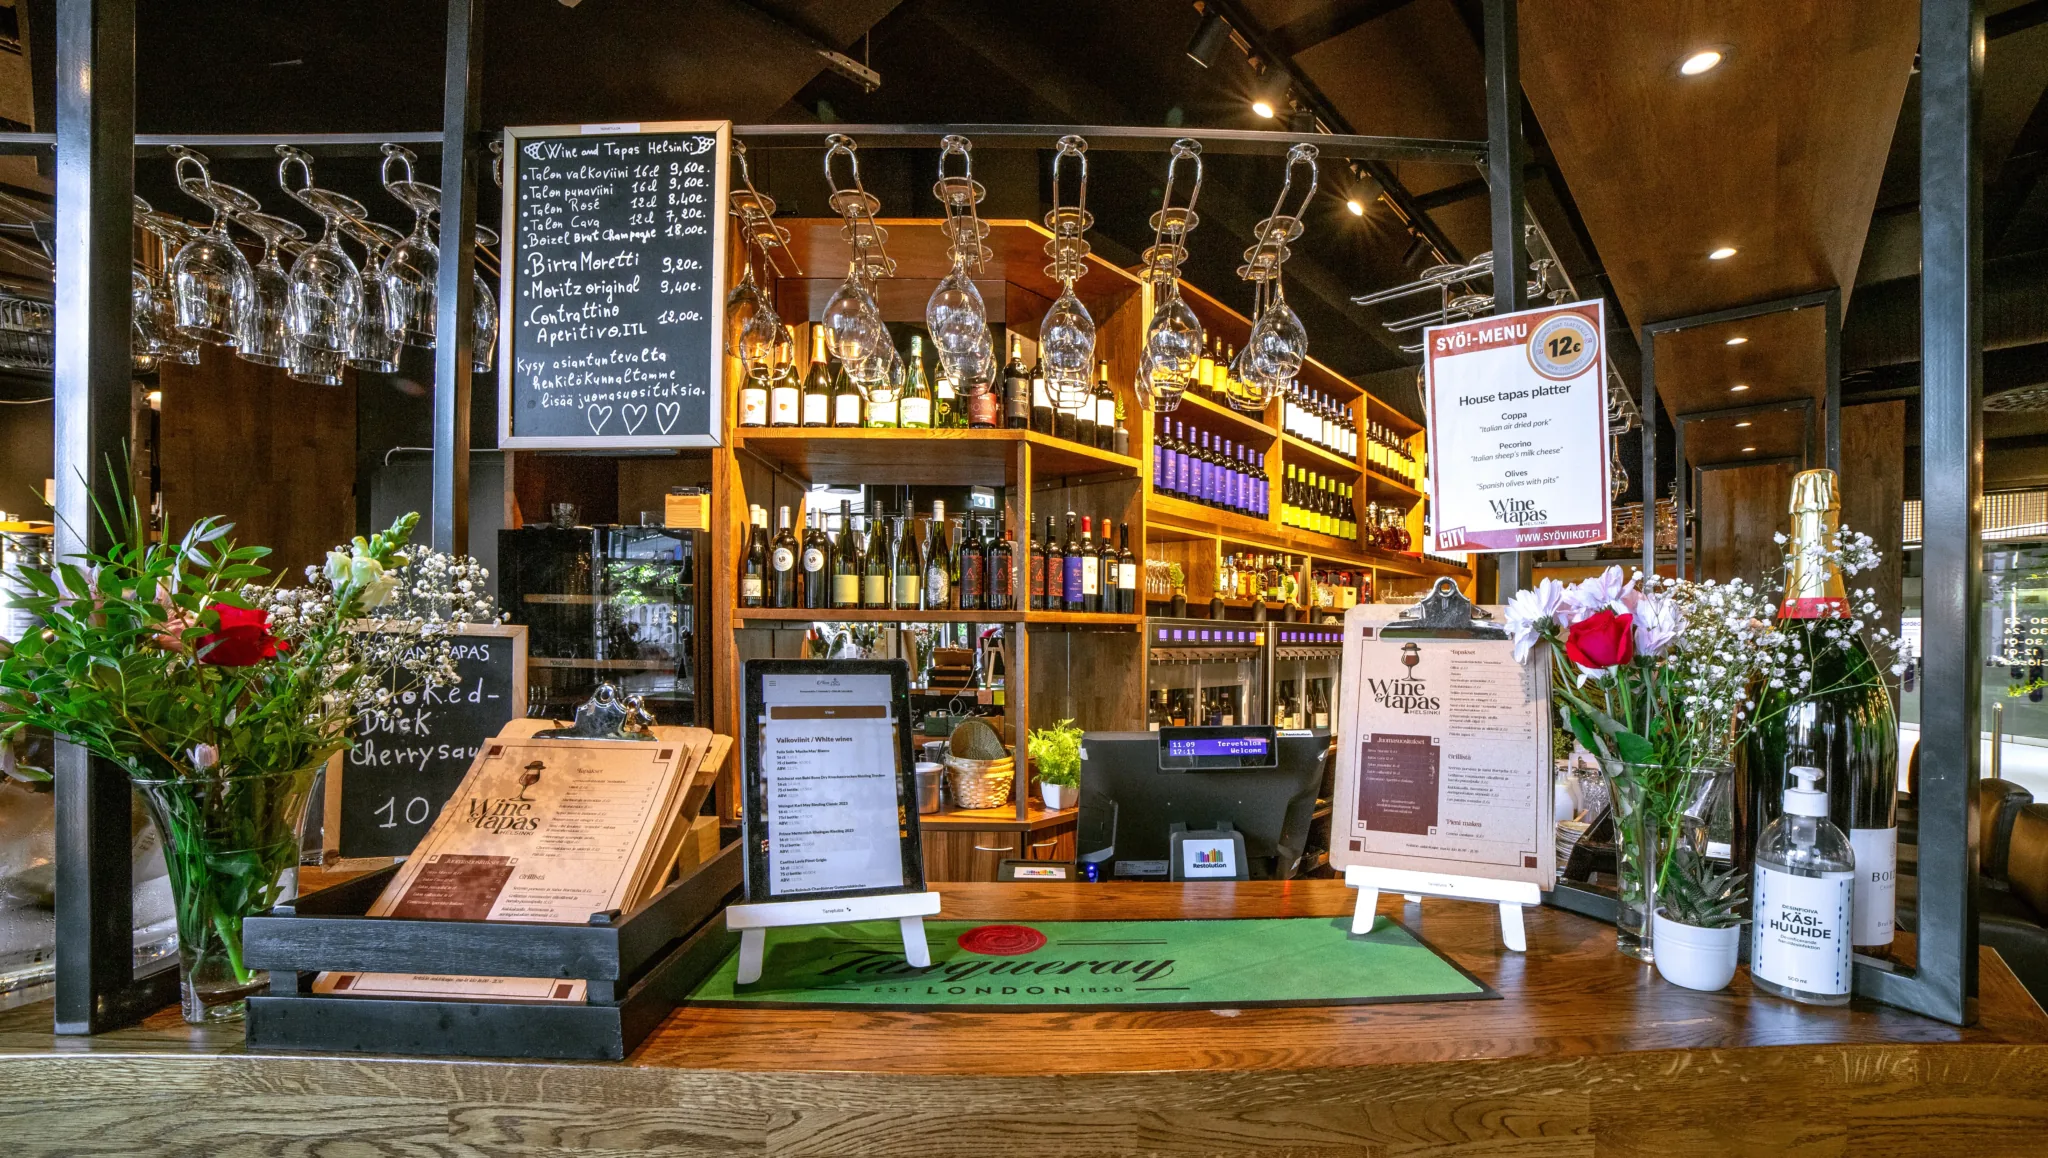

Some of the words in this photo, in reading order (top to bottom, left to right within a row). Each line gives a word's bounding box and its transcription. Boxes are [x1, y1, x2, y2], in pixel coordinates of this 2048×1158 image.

[544, 143, 577, 159] Wine
[582, 144, 599, 157] and
[604, 142, 640, 160] Tapas
[648, 140, 693, 154] Helsinki
[528, 167, 562, 181] Talon
[566, 167, 629, 180] valkoviini
[529, 185, 561, 199] Talon
[564, 184, 614, 202] punaviini
[530, 203, 563, 216] Talon
[571, 198, 600, 213] Rosé
[530, 218, 563, 231] Talon
[570, 215, 600, 229] Cava
[528, 232, 571, 248] Boizel
[574, 232, 599, 244] Brut
[602, 229, 657, 246] Champagne
[527, 252, 577, 278] Birra
[580, 250, 640, 272] Moretti
[532, 280, 582, 299] Moritz
[585, 275, 641, 303] original
[530, 302, 620, 326] Contrattino
[1436, 323, 1528, 351] SYÖ!-MENU
[516, 357, 545, 378] Kysy
[552, 347, 667, 370] asiantuntevalta
[532, 368, 676, 391] henkilökunnaltamme
[541, 393, 573, 409] lisää
[577, 383, 706, 410] juomasuosituksia.
[1459, 395, 1496, 407] House
[1498, 389, 1529, 402] tapas
[1531, 383, 1572, 398] platter
[1501, 411, 1528, 421] Coppa
[1514, 420, 1532, 429] dried
[1499, 440, 1532, 450] Pecorino
[1521, 449, 1535, 457] milk
[1504, 470, 1528, 478] Olives
[1505, 478, 1525, 487] olives
[1526, 477, 1542, 486] with
[1489, 498, 1535, 513] Wine
[1439, 527, 1465, 549] CITY
[1515, 529, 1600, 543] WWW.SYÖVIIKOT.FI
[1368, 679, 1425, 696] Wine
[1377, 737, 1425, 745] Juomasuositukset
[469, 798, 531, 817] Wine
[1781, 904, 1819, 915] DESINFIOIVA
[1782, 911, 1823, 927] KÄSI-
[1770, 919, 1832, 939] HUUHDE
[926, 986, 1070, 995] LONDON
